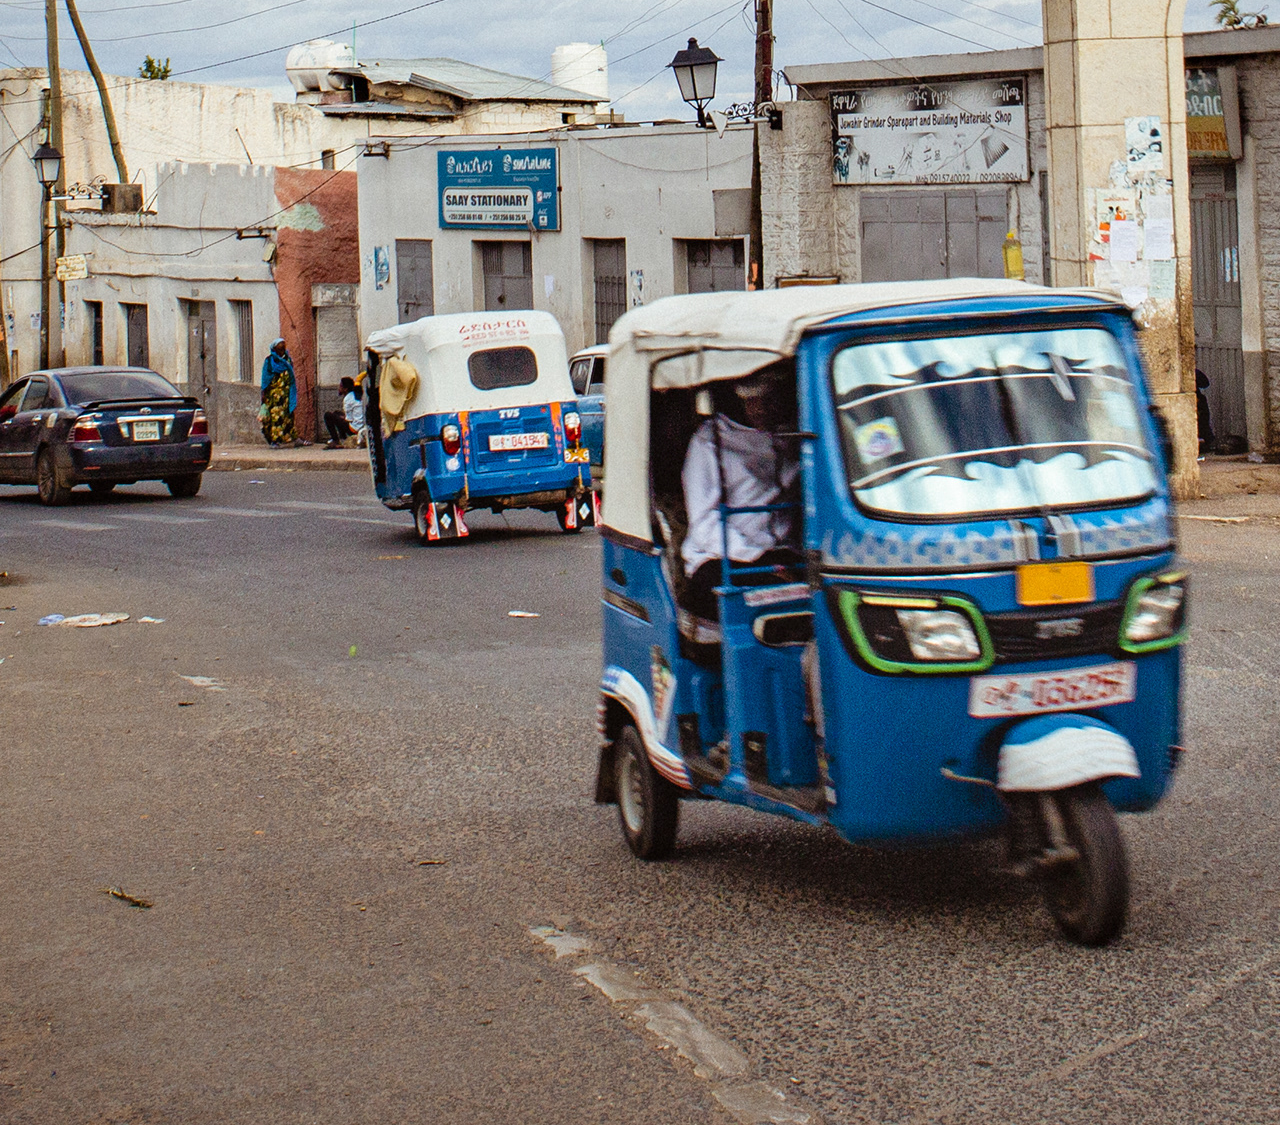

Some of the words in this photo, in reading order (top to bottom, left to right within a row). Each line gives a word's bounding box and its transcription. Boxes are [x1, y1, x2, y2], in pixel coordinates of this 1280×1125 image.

[840, 116, 862, 129] Jewahir
[863, 116, 886, 129] Grinder
[887, 114, 918, 130] Sparepart
[919, 115, 931, 125] and
[932, 113, 959, 128] Building
[959, 111, 992, 125] Materials
[995, 110, 1012, 125] Shop
[446, 194, 469, 206] SAAY
[471, 194, 528, 206] STATIONARY
[499, 409, 520, 419] TVS
